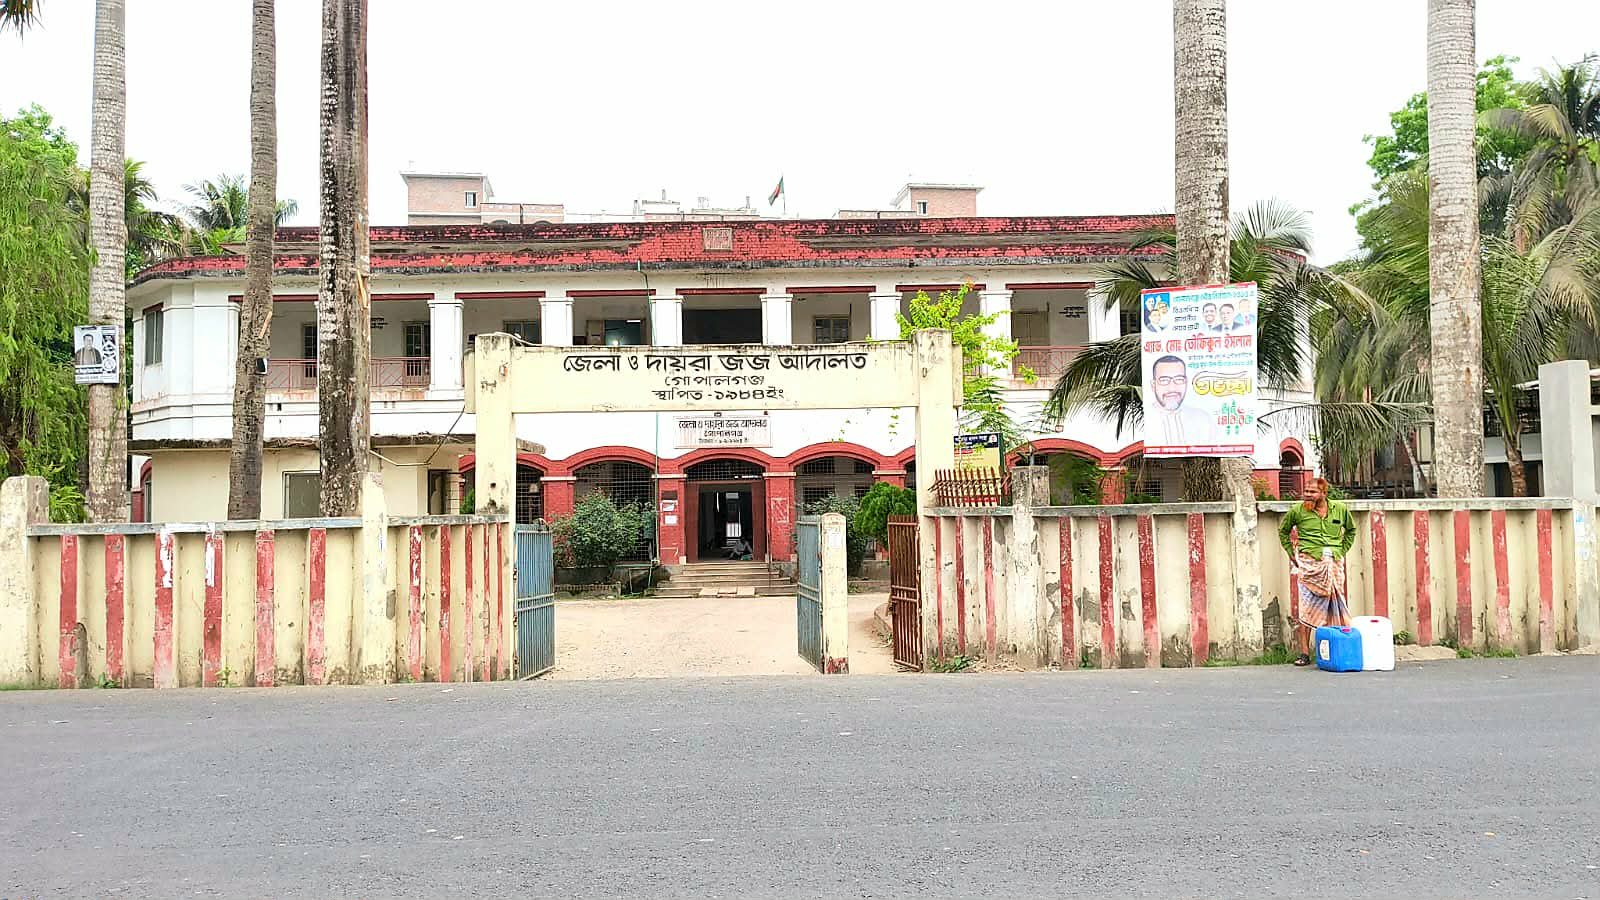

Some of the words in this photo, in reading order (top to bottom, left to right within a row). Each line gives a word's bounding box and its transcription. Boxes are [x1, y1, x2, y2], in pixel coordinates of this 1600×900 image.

[1224, 333, 1253, 349] ইসলাম
[563, 354, 621, 372] জেলা
[628, 356, 639, 370] ও
[644, 354, 712, 372] দায়রা
[718, 353, 770, 371] জজ
[777, 352, 868, 371] আদালত
[664, 375, 765, 386] গোপালগঞ্জ
[651, 387, 703, 401] স্থাপিত
